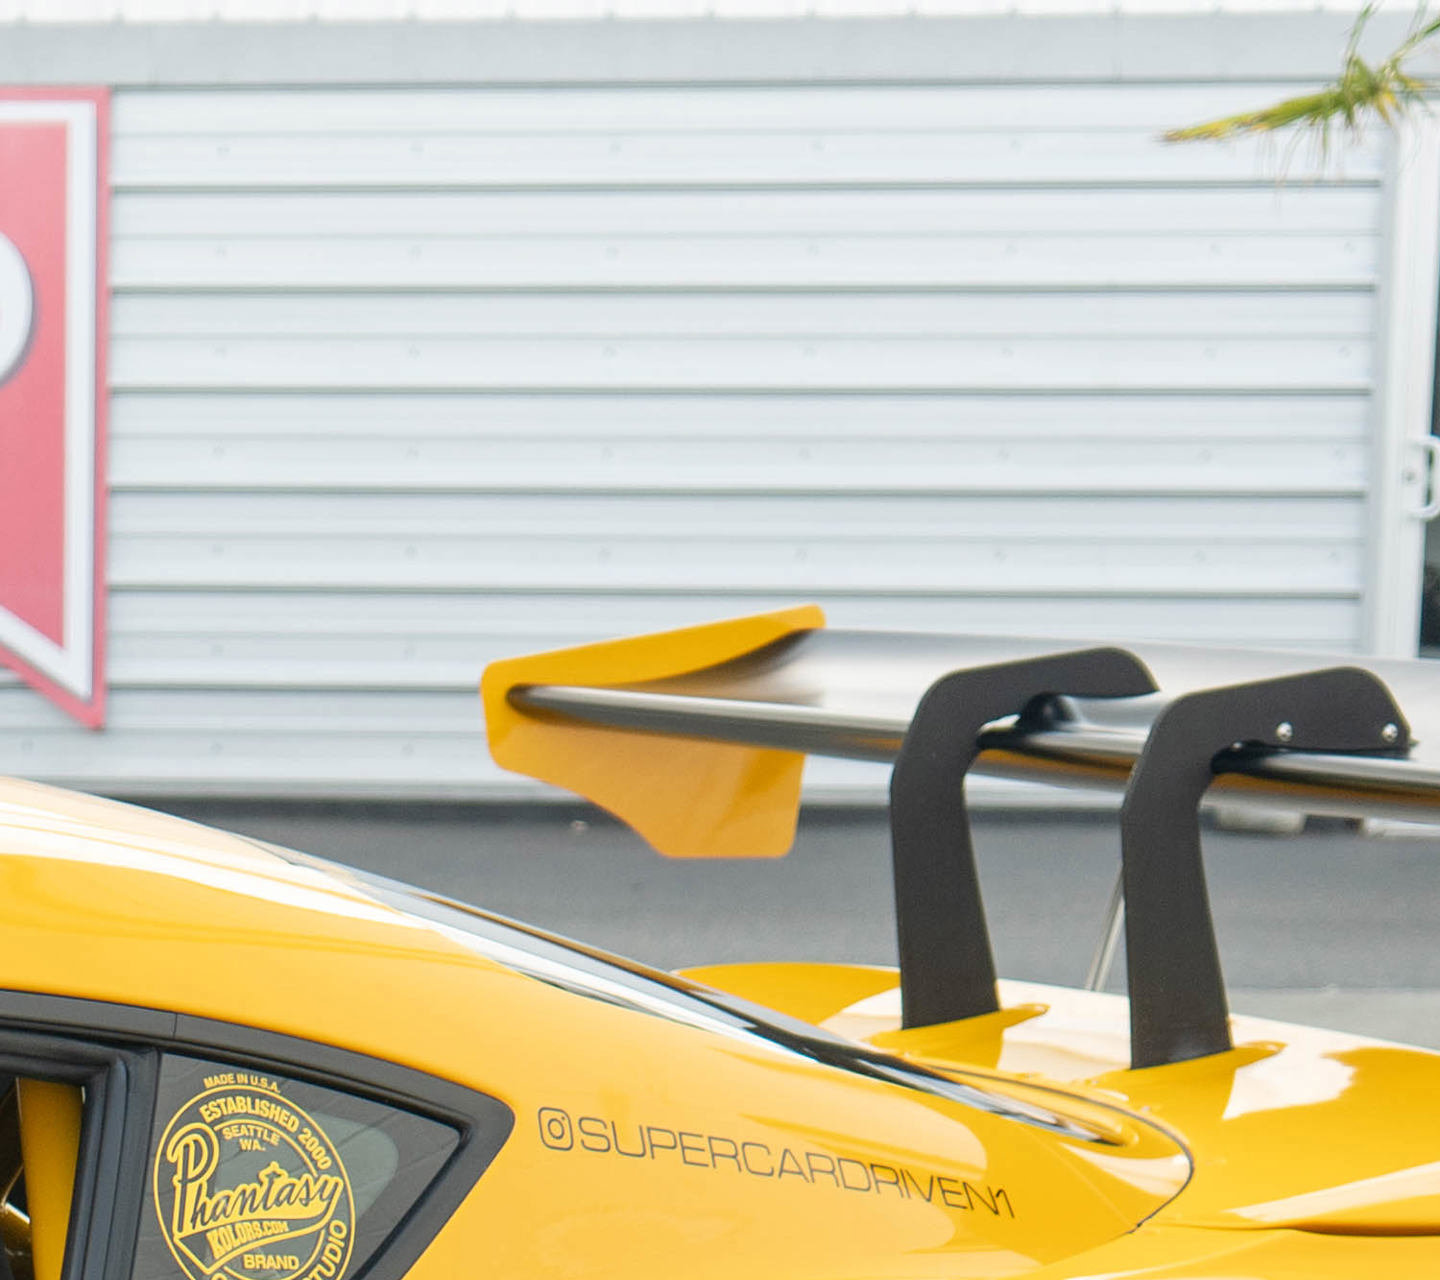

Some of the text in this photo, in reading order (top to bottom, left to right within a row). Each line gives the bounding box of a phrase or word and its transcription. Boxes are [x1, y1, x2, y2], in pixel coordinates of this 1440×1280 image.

[203, 1073, 235, 1088] MADE
[236, 1074, 249, 1085] IN
[199, 1096, 333, 1171] ESTABLISHED 2000
[222, 1125, 281, 1147] SEATTLE
[239, 1139, 266, 1151] WA.
[577, 1115, 1016, 1219] SUPERCARDRIVEN1
[167, 1122, 344, 1240] Phantasy
[243, 1254, 300, 1270] BRAND
